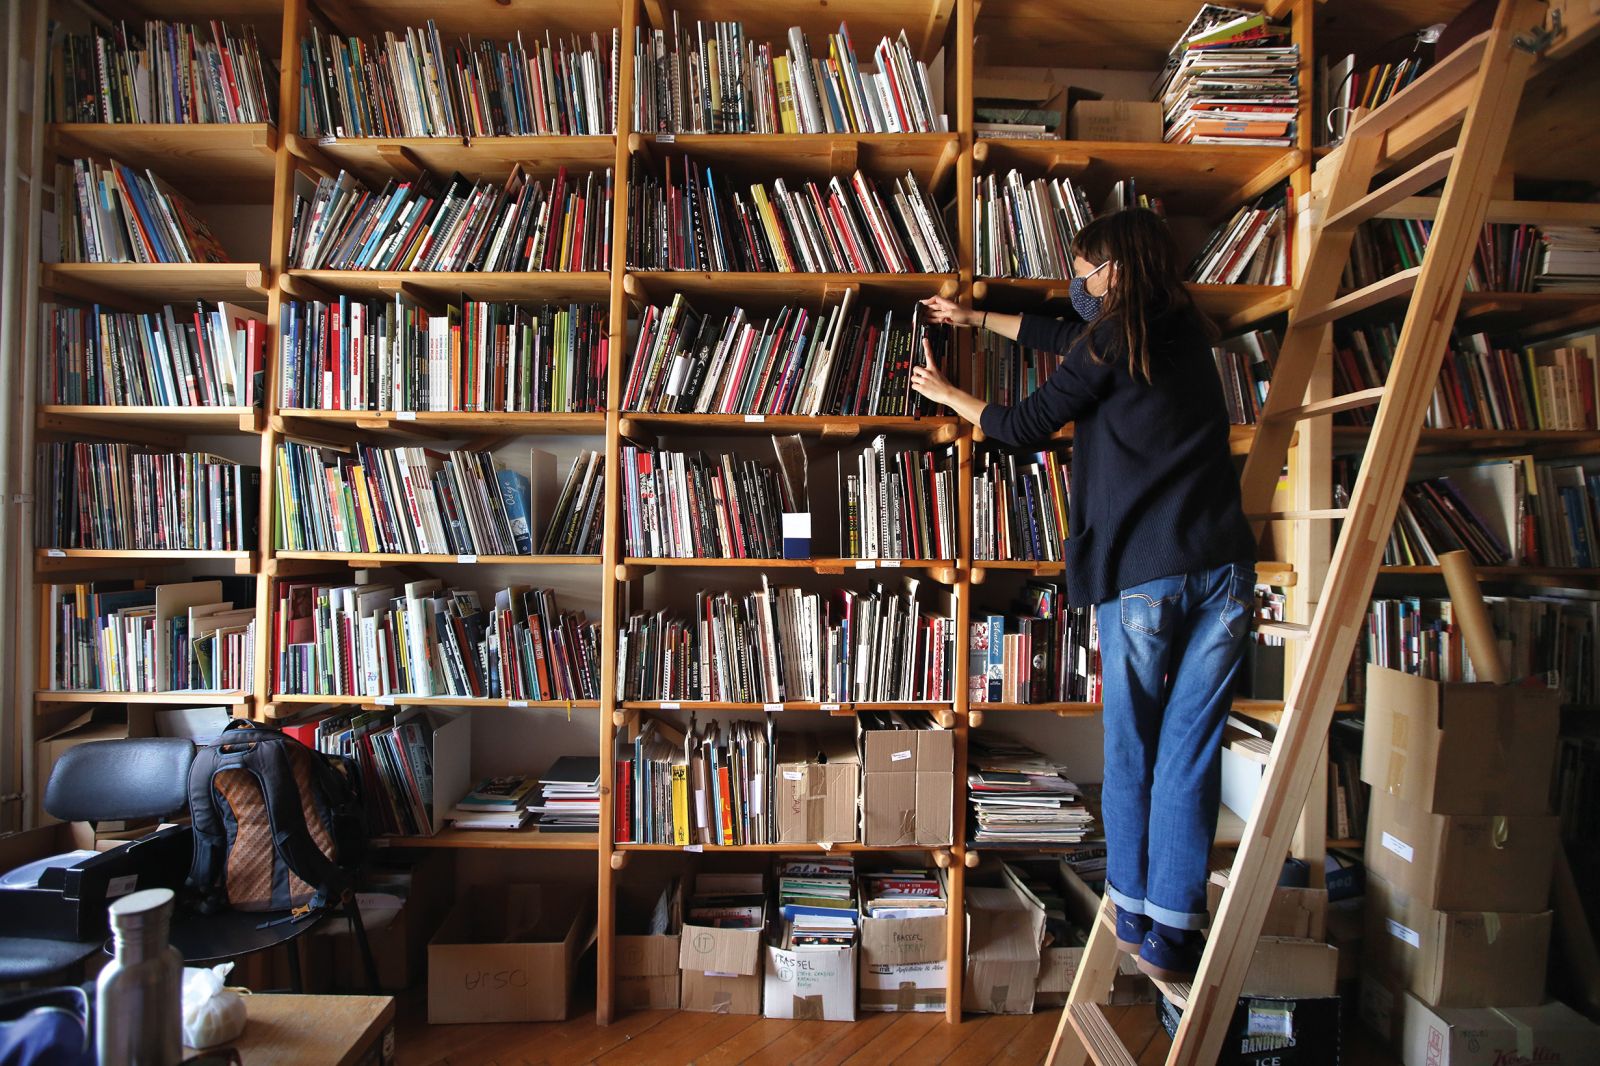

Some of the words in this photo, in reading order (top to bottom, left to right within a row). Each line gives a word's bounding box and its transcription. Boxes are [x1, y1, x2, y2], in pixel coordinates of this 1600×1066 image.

[694, 211, 705, 258] MACACO
[698, 936, 711, 951] IT
[1255, 1057, 1281, 1066] ICE
